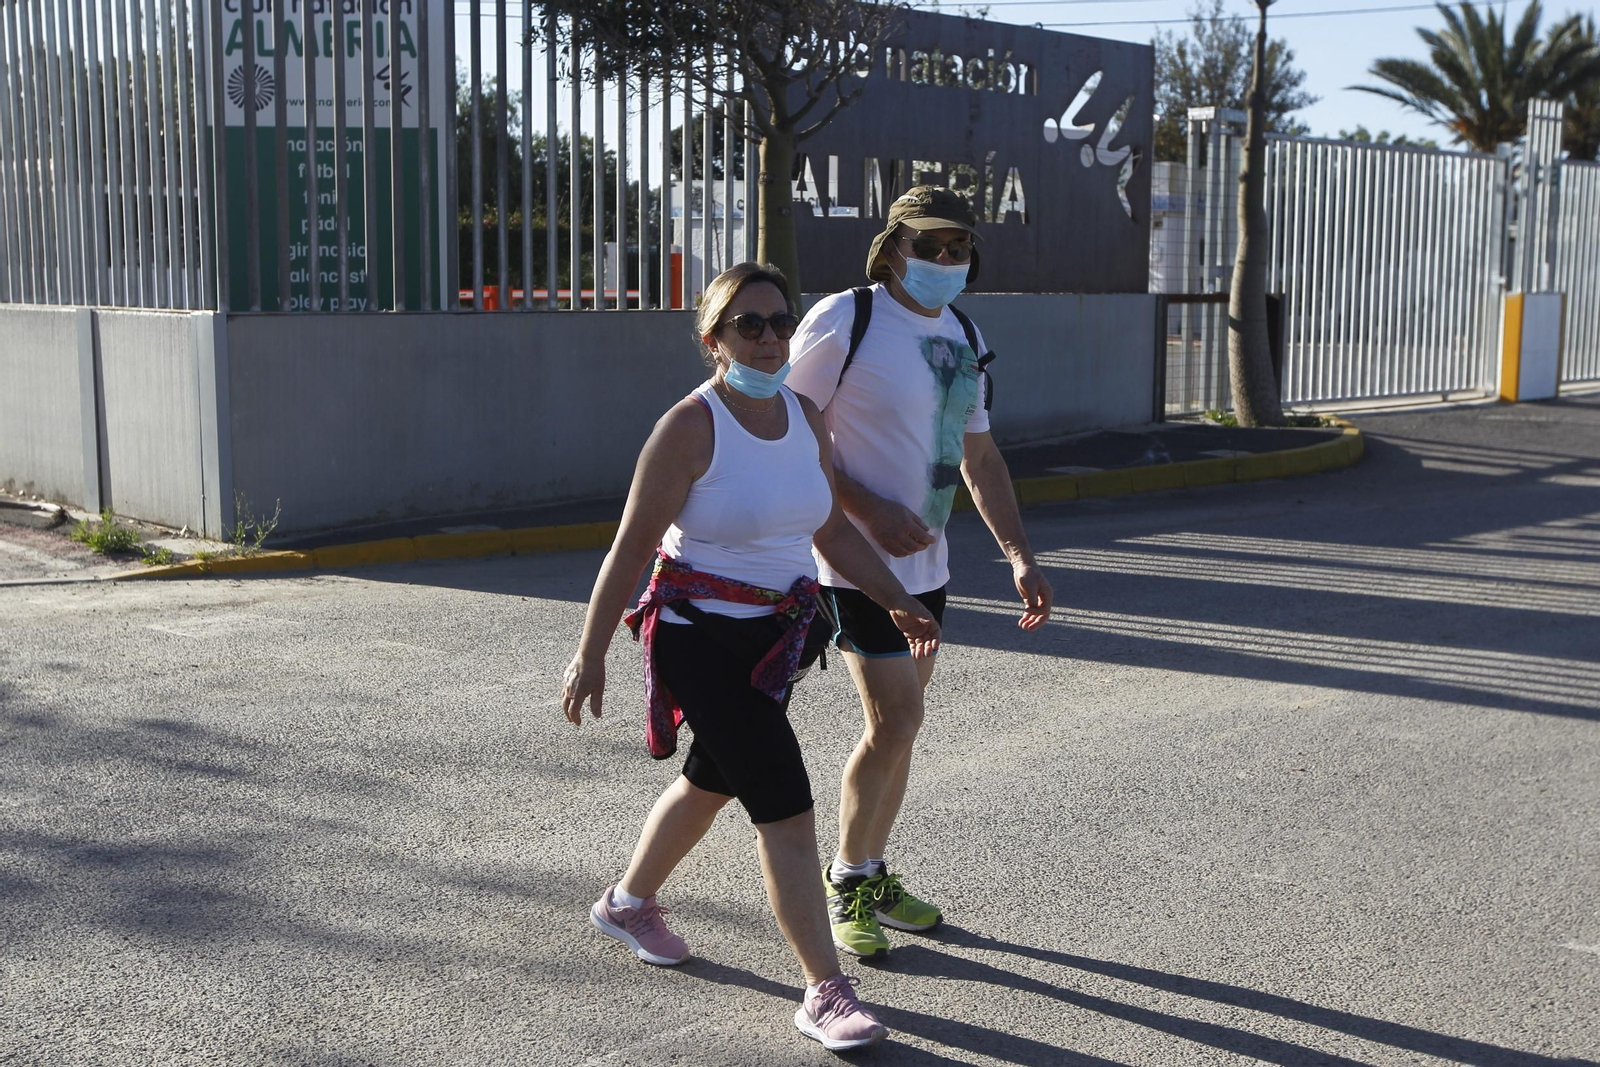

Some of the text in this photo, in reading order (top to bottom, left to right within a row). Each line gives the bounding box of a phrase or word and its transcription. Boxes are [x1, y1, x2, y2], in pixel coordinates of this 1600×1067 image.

[886, 47, 1037, 95] natación
[286, 136, 364, 153] naacón
[298, 163, 350, 178] ftbl
[303, 190, 338, 205] tni
[302, 215, 350, 234] pádl
[330, 297, 367, 312] pay
